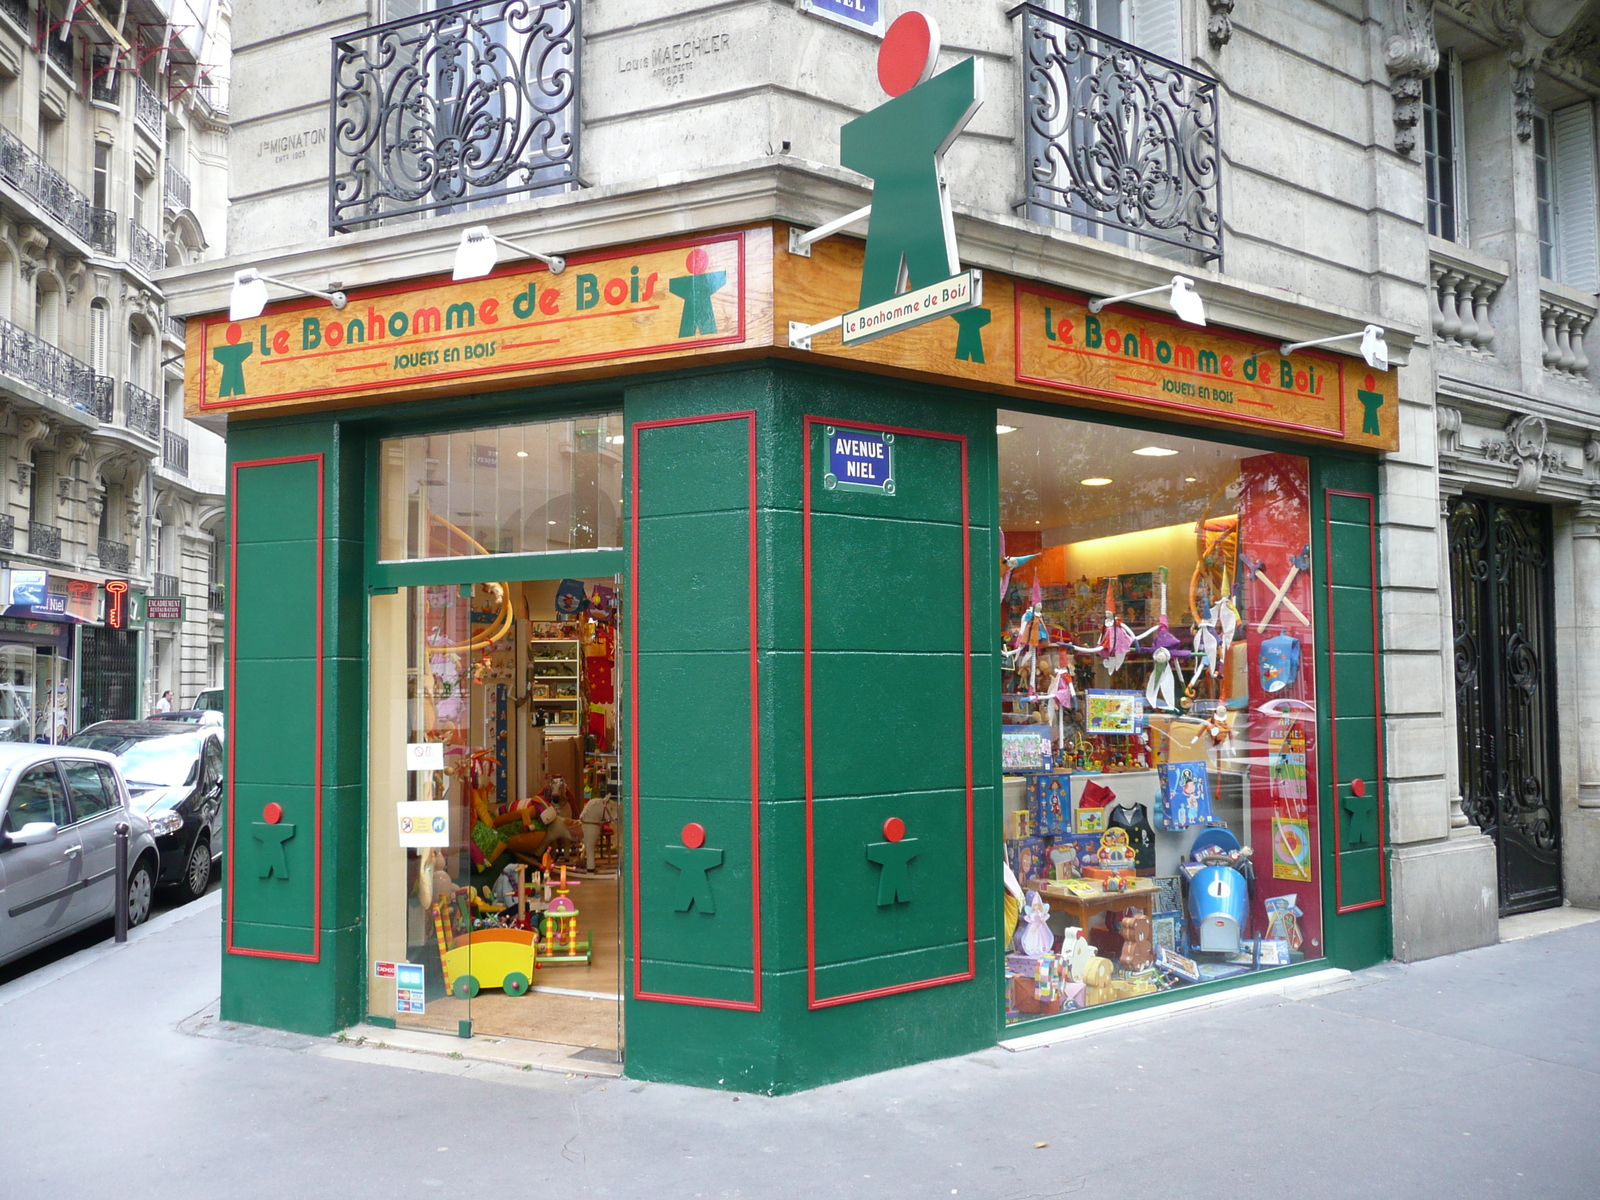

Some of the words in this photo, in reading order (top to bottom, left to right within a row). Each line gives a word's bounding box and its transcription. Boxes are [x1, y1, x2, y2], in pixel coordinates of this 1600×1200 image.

[651, 33, 730, 68] MAECHLER
[270, 127, 326, 155] MIGNATON
[260, 324, 291, 356] Le
[302, 297, 500, 351] Bonhomme
[512, 282, 561, 320] de
[576, 265, 659, 311] Bois
[859, 300, 920, 330] Bonhomme
[923, 294, 938, 309] de
[942, 284, 967, 303] Bois
[393, 350, 439, 370] JOUETS
[464, 341, 496, 360] BOIS
[1044, 306, 1074, 345] Le
[1084, 314, 1235, 379] Bonhomme
[1243, 352, 1272, 385] de
[1280, 359, 1325, 396] Bois
[1161, 377, 1197, 399] JOUETS
[1212, 387, 1234, 405] BOIS
[835, 438, 885, 459] AVENUE
[846, 460, 876, 479] NIEL
[49, 598, 65, 612] Niel
